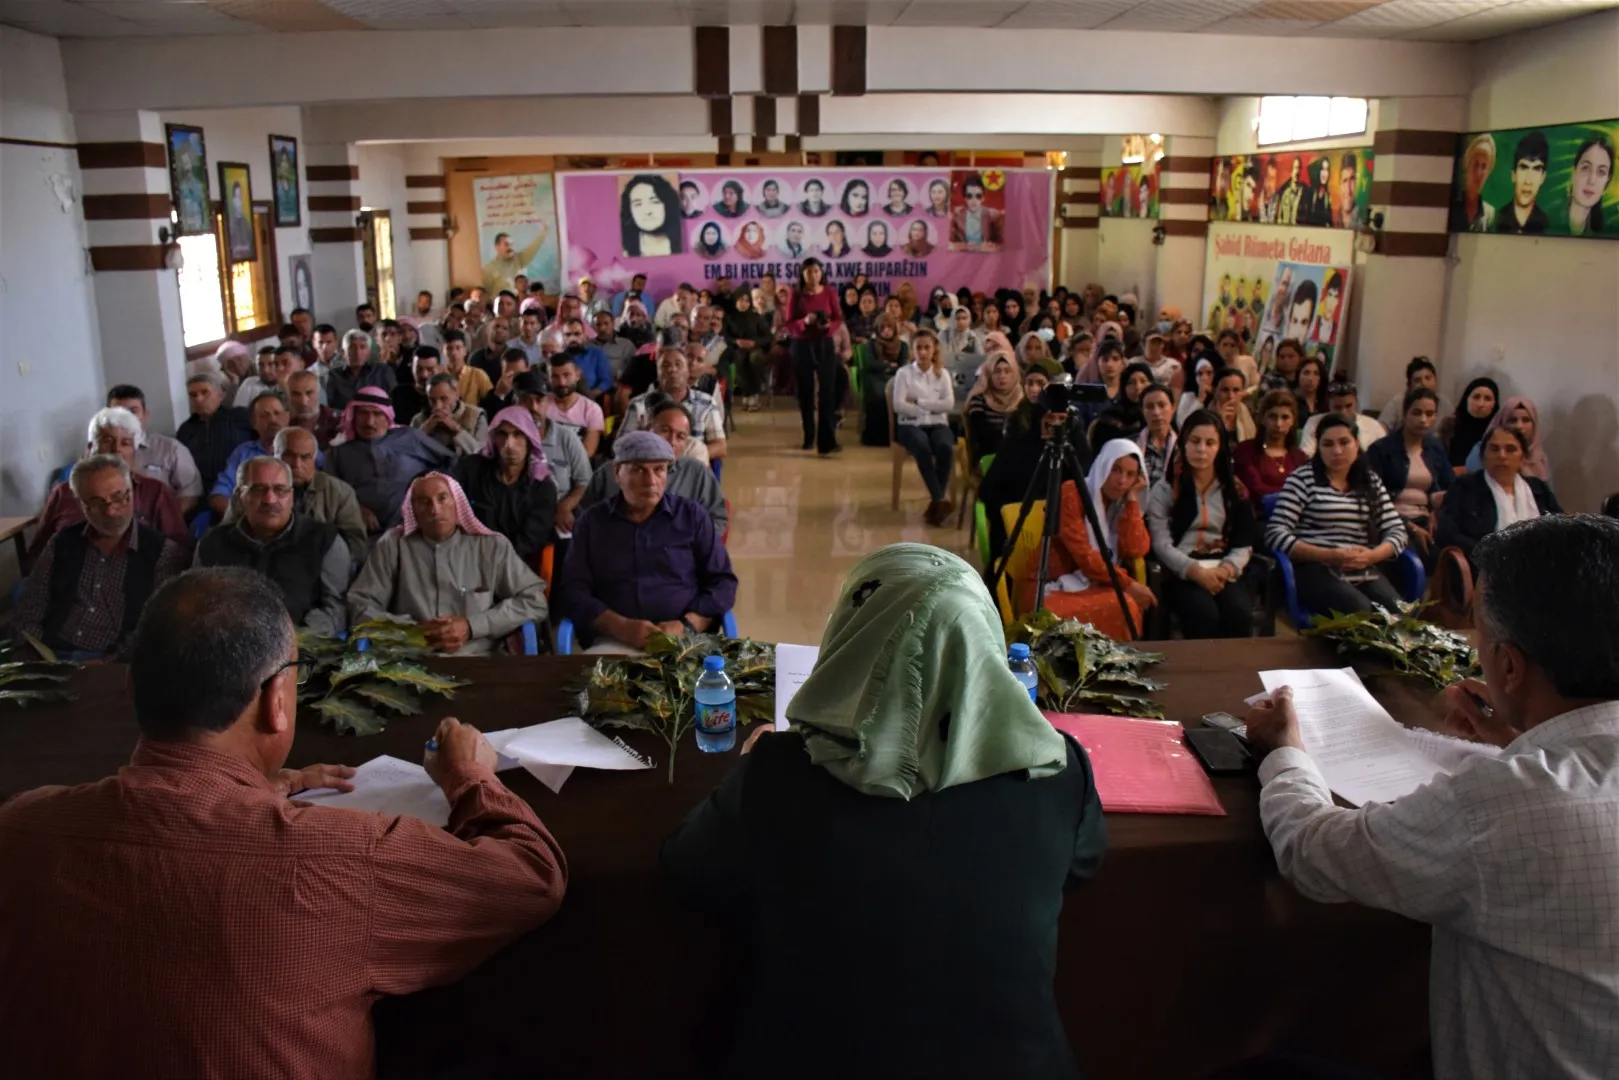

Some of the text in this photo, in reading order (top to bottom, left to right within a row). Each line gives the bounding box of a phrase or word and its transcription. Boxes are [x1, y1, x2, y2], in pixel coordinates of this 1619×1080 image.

[704, 263, 721, 279] EM
[725, 263, 738, 278] BI
[741, 263, 765, 279] HEV
[836, 262, 862, 277] XWE
